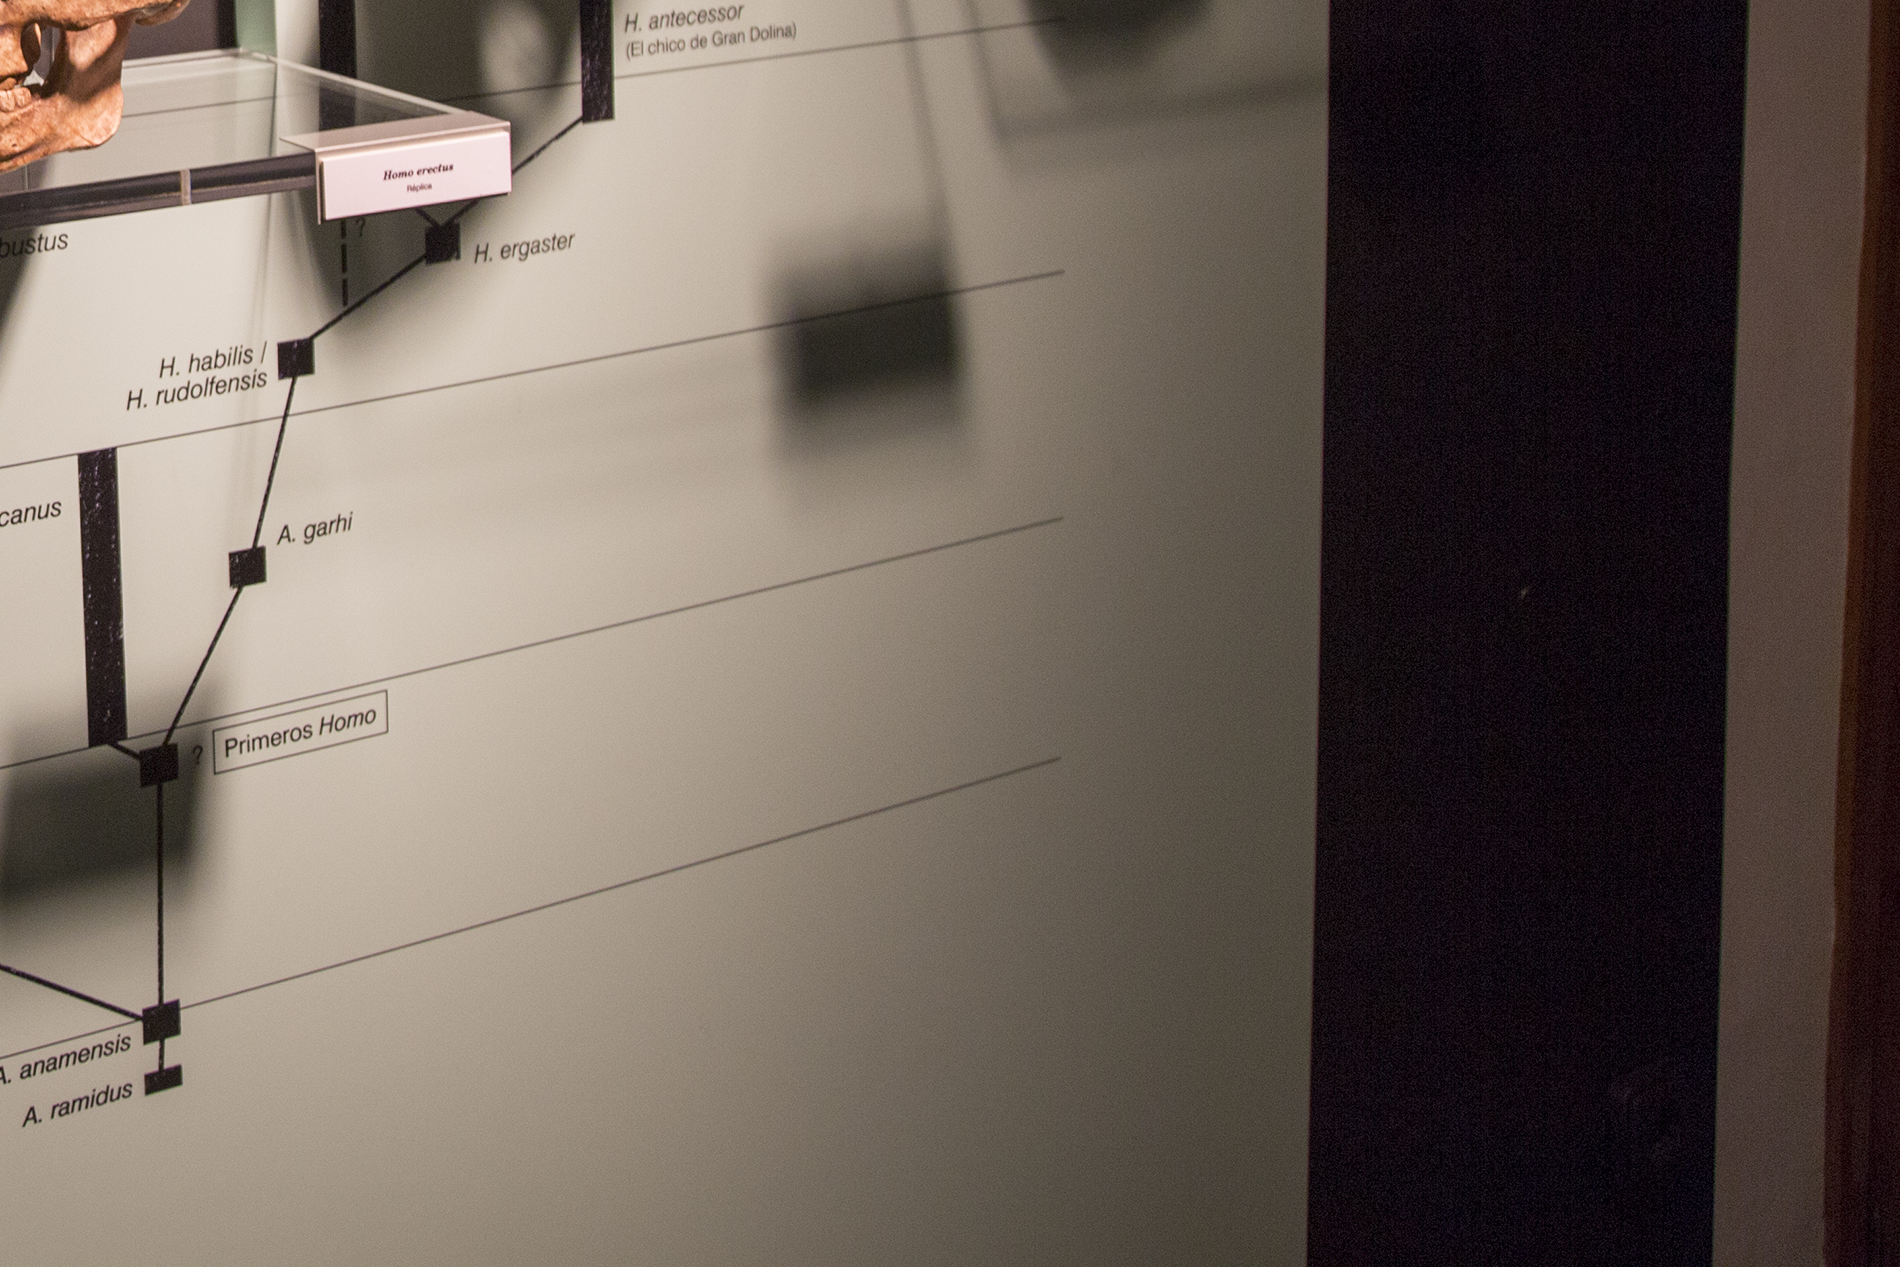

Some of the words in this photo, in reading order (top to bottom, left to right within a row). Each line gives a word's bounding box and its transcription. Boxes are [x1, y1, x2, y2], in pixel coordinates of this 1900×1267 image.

[624, 13, 644, 32] H.
[648, 1, 744, 30] antecessor
[625, 40, 644, 60] (El
[647, 35, 686, 56] chico
[689, 33, 708, 52] de
[711, 27, 745, 49] Gran
[749, 21, 797, 45] Dolina)
[383, 168, 414, 181] Homo
[416, 163, 454, 176] erectus
[474, 243, 494, 264] H.
[499, 232, 576, 261] ergaster
[158, 356, 180, 378] H.
[188, 345, 254, 373] habilis
[126, 389, 147, 410] H.
[155, 369, 267, 406] rudolfensis
[277, 524, 296, 546] A.
[303, 512, 353, 545] garhi
[225, 722, 313, 758] Primeros
[319, 706, 377, 737] Homo
[192, 745, 203, 765] ?
[19, 1033, 131, 1079] anamensis
[22, 1105, 43, 1127] A.
[50, 1080, 133, 1121] ramidus
